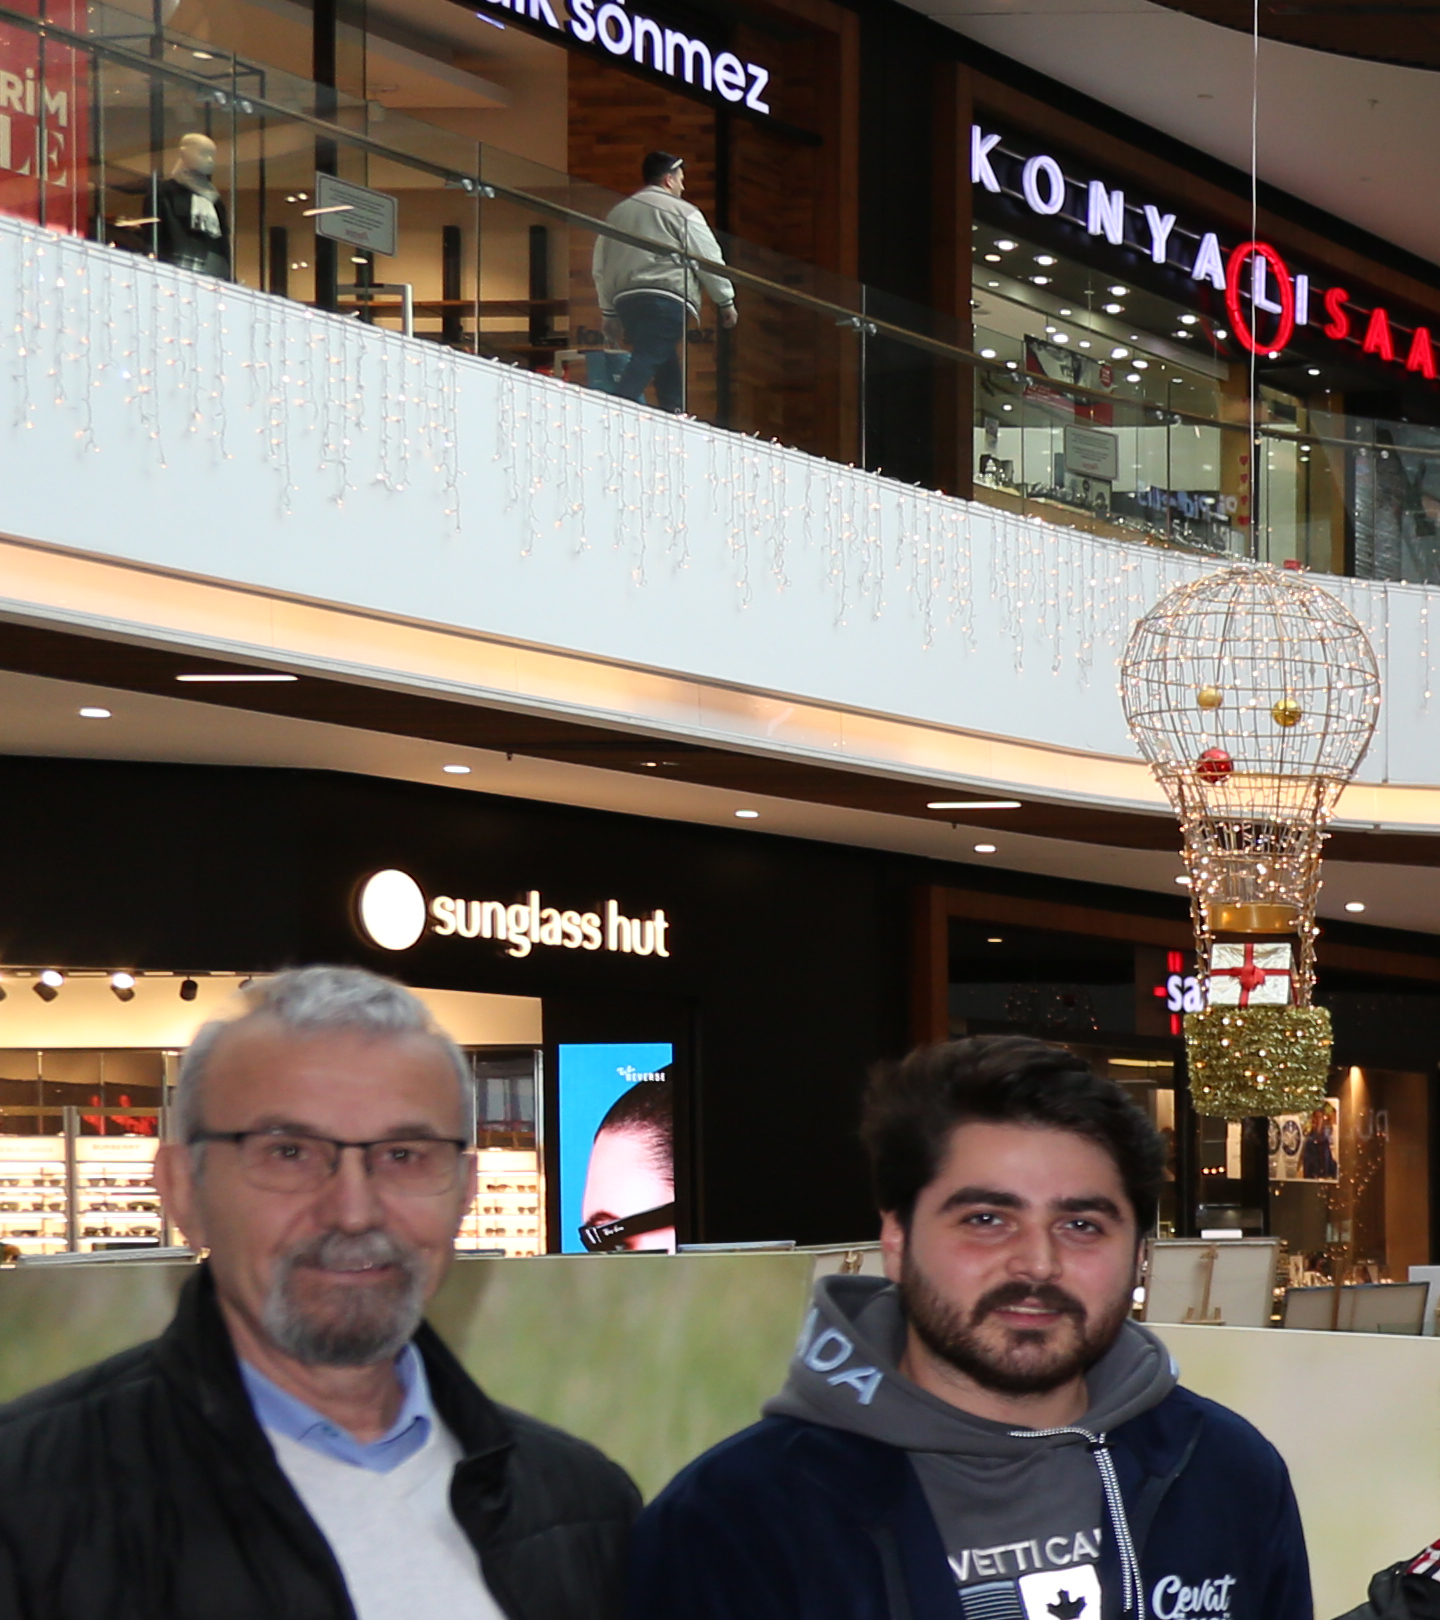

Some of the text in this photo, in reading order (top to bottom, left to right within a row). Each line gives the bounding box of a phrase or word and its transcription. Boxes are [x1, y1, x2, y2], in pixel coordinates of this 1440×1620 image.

[430, 889, 670, 958] sunglass hut
[1151, 1574, 1237, 1620] Cevat
